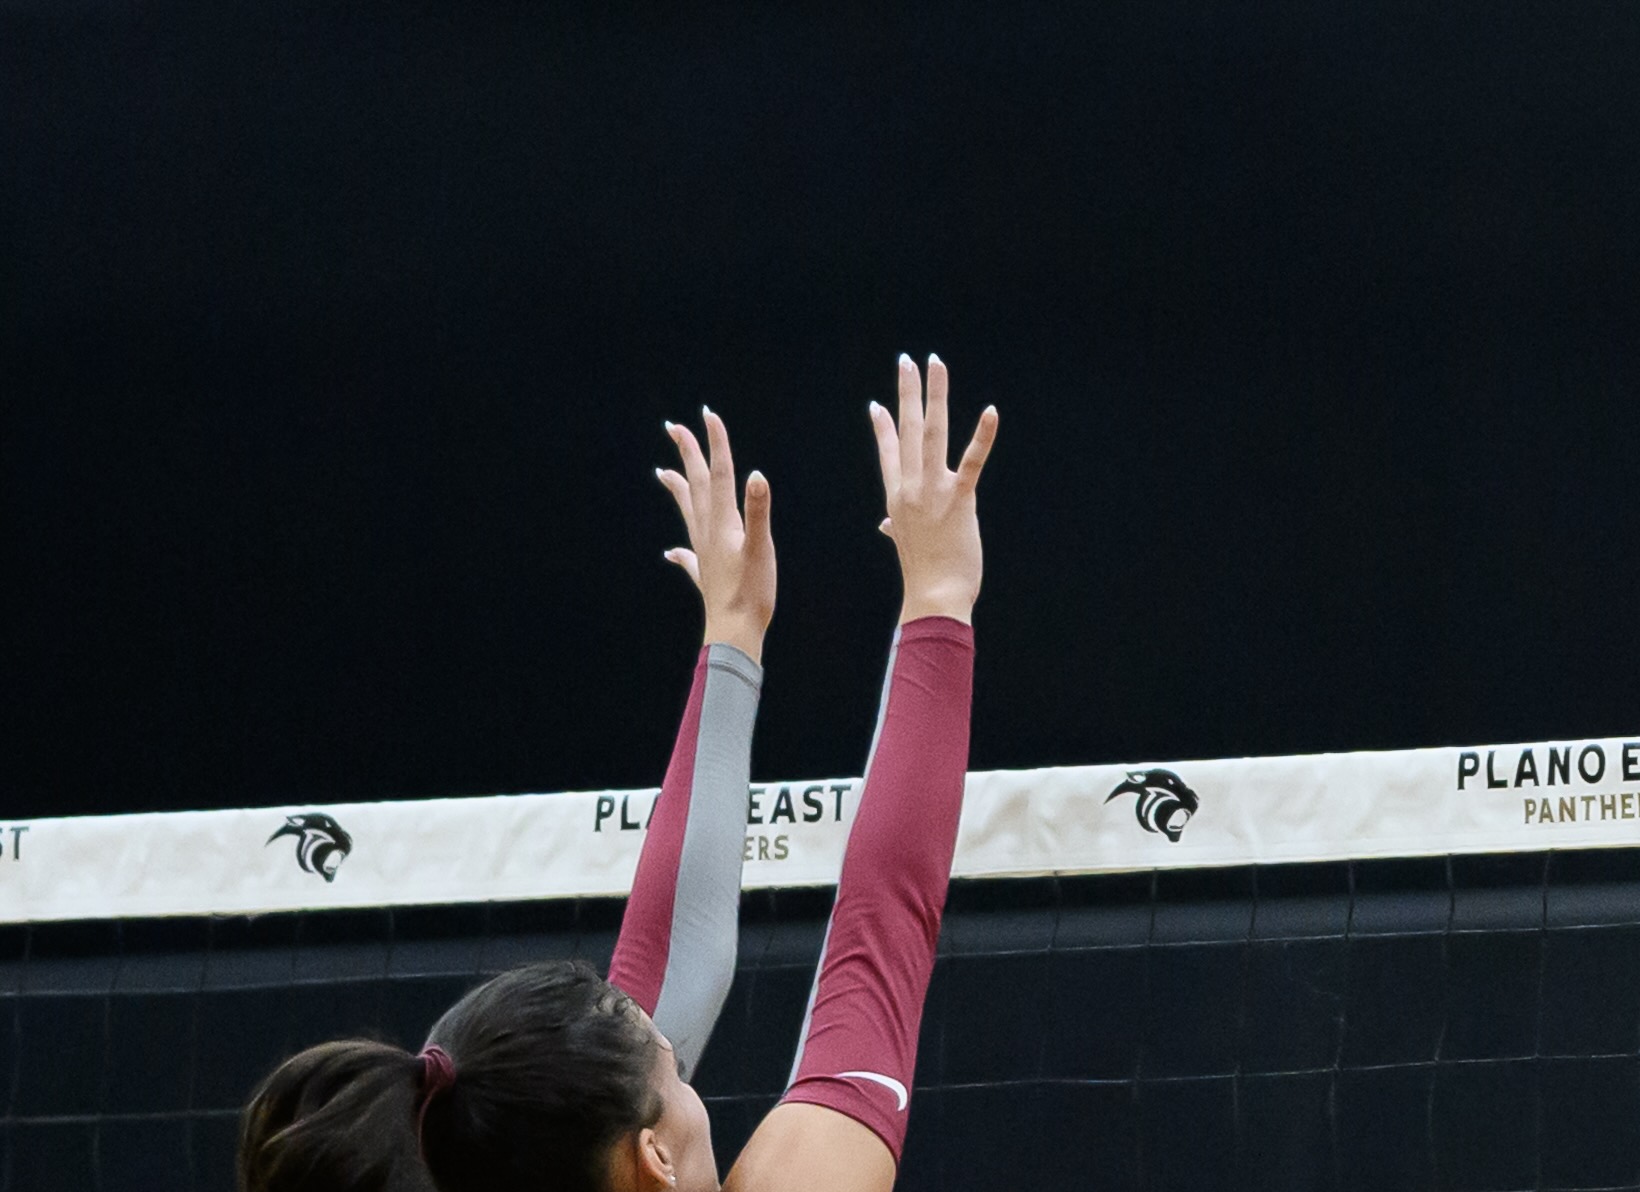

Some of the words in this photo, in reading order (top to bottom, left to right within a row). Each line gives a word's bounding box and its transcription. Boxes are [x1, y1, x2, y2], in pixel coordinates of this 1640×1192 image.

[1457, 743, 1606, 791] PLANO
[593, 793, 660, 833] PL
[747, 784, 853, 825] EAST
